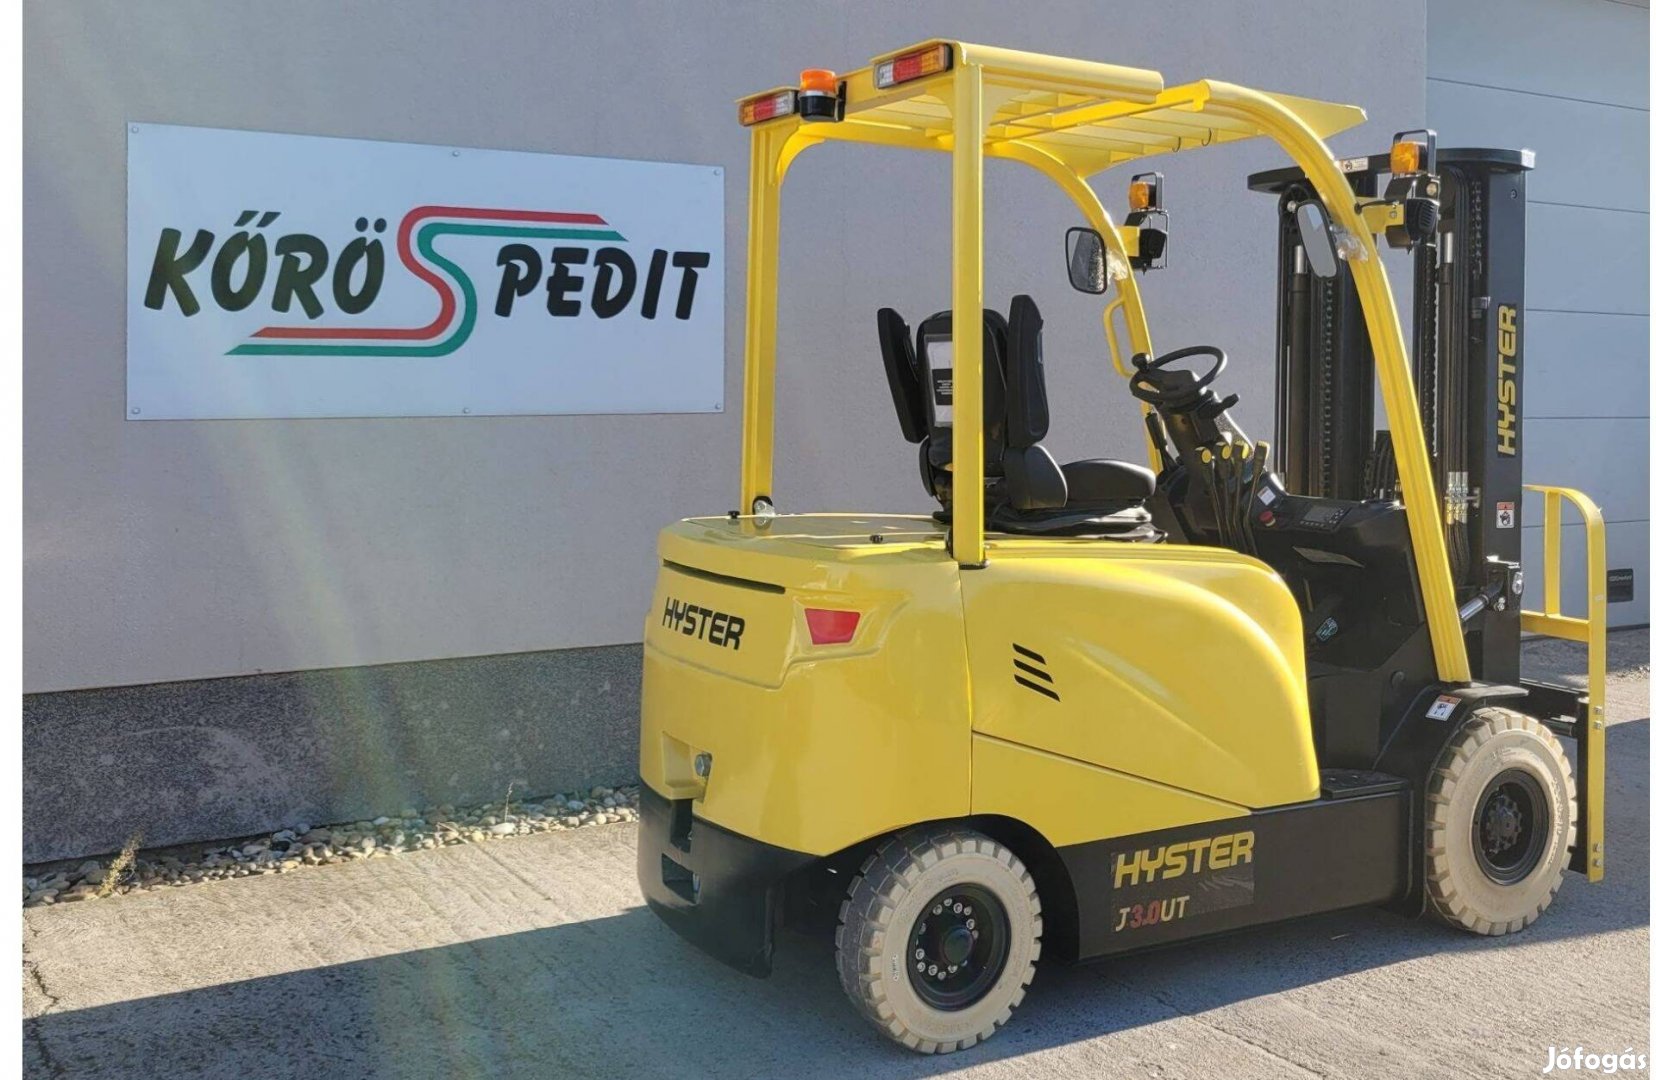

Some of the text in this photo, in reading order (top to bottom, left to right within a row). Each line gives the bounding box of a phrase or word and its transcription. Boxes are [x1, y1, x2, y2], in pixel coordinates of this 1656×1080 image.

[1497, 305, 1516, 456] HYSTER
[662, 596, 746, 651] HYSTER
[1113, 831, 1255, 889] HYSTER
[1115, 895, 1190, 932] J3.0UT
